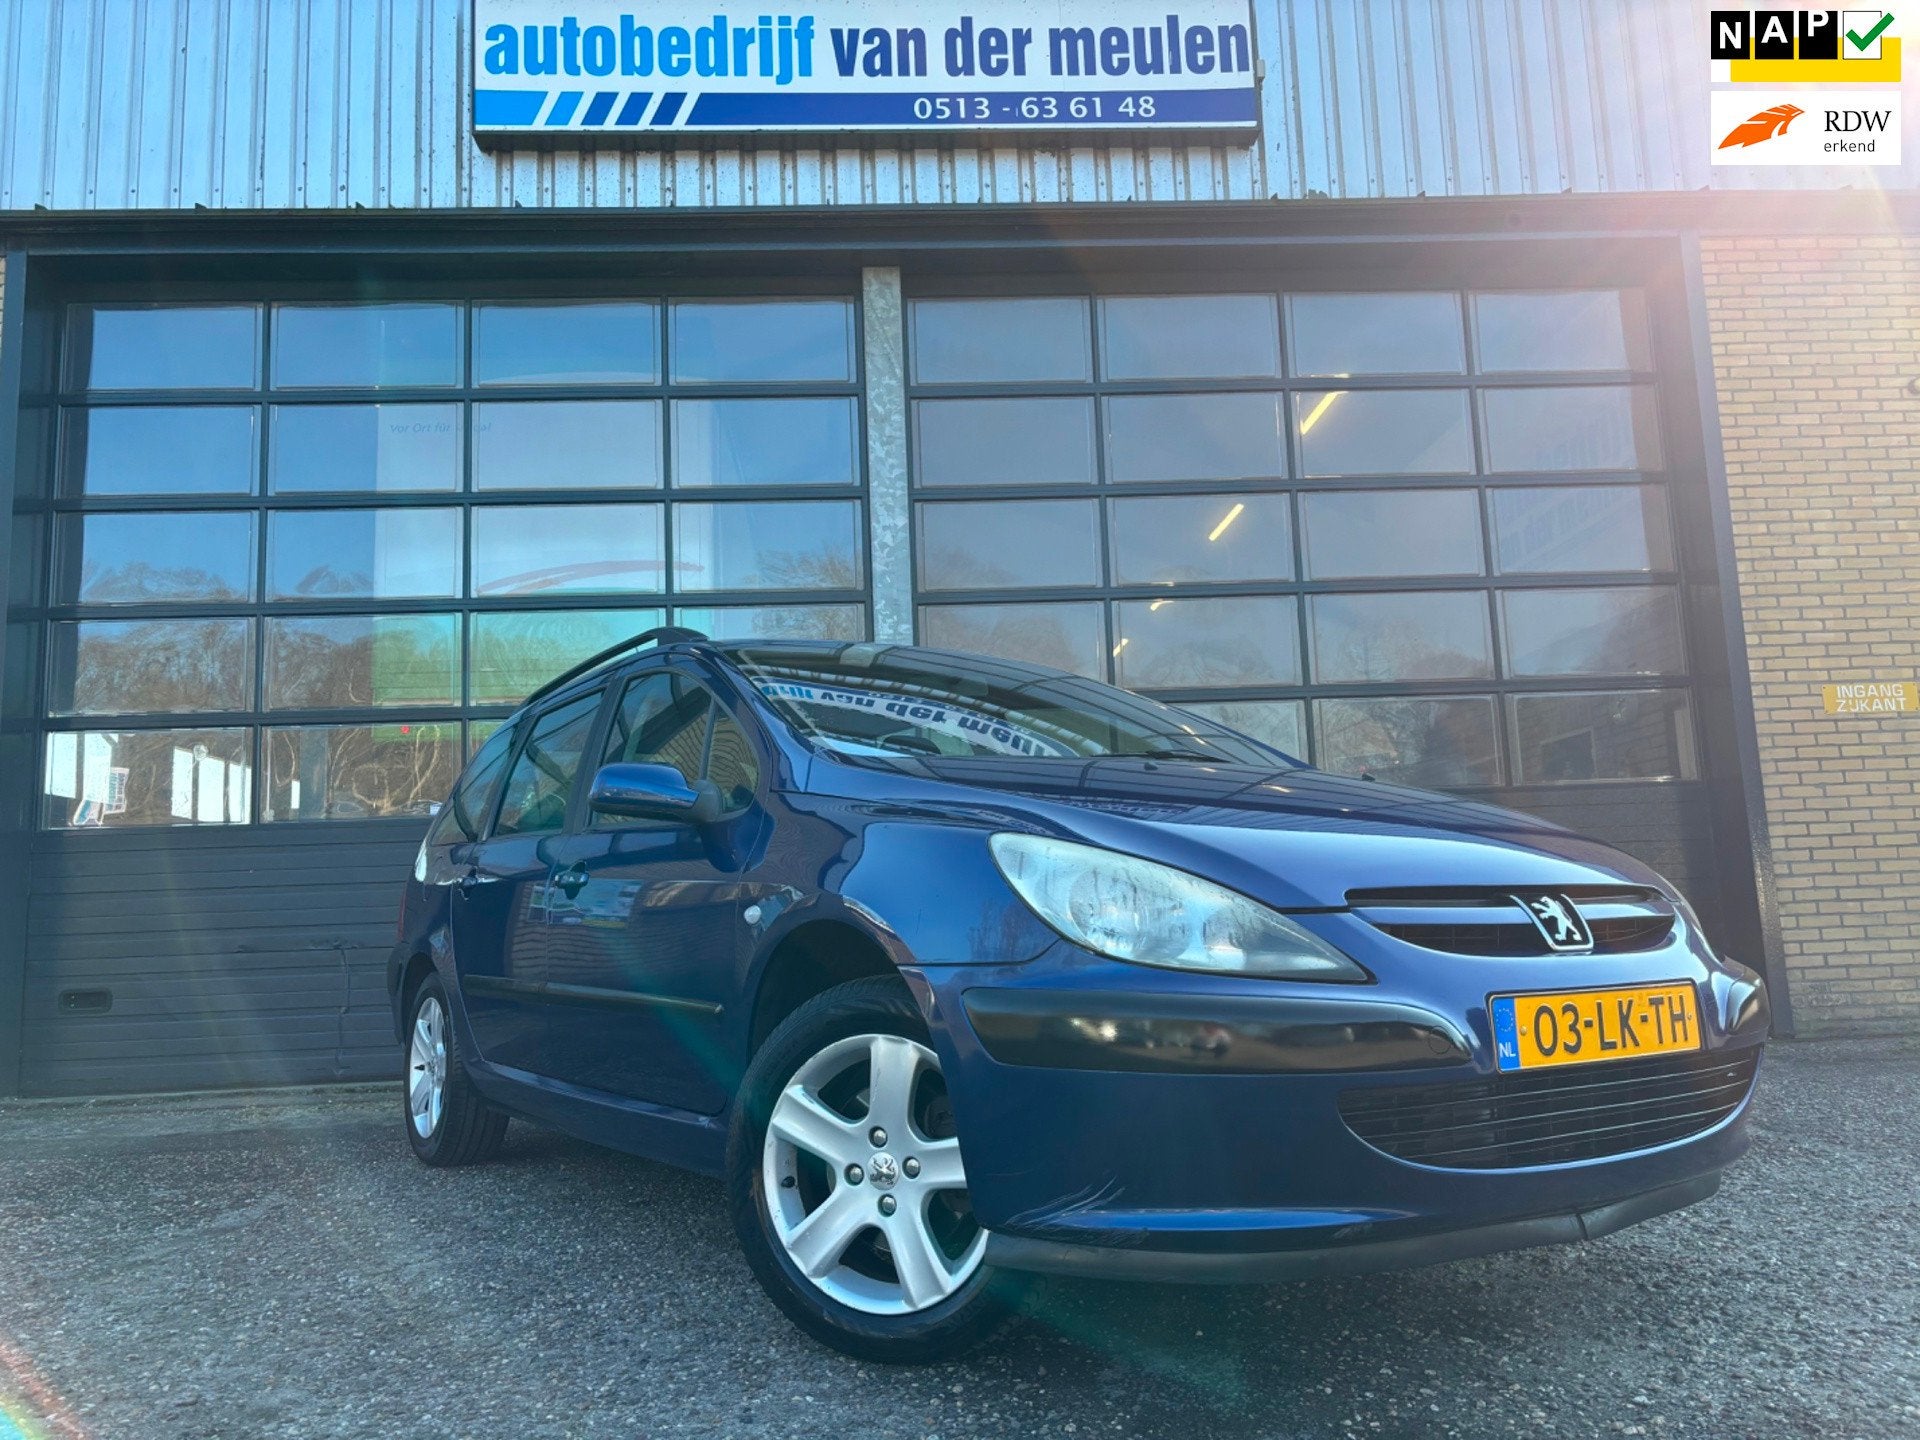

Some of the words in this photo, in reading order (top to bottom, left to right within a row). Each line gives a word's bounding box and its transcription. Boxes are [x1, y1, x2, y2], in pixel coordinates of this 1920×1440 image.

[484, 14, 815, 86] autobedrijf
[830, 26, 927, 78] van
[944, 15, 1032, 77] der
[1048, 14, 1251, 77] meulen
[913, 97, 991, 120] 0513
[1020, 97, 1059, 119] 63
[1069, 97, 1102, 118] 61
[1117, 96, 1156, 118] 48
[1836, 683, 1904, 698] INGANG
[1533, 994, 1689, 1057] 03-LK-TH
[1499, 1042, 1517, 1058] NL
